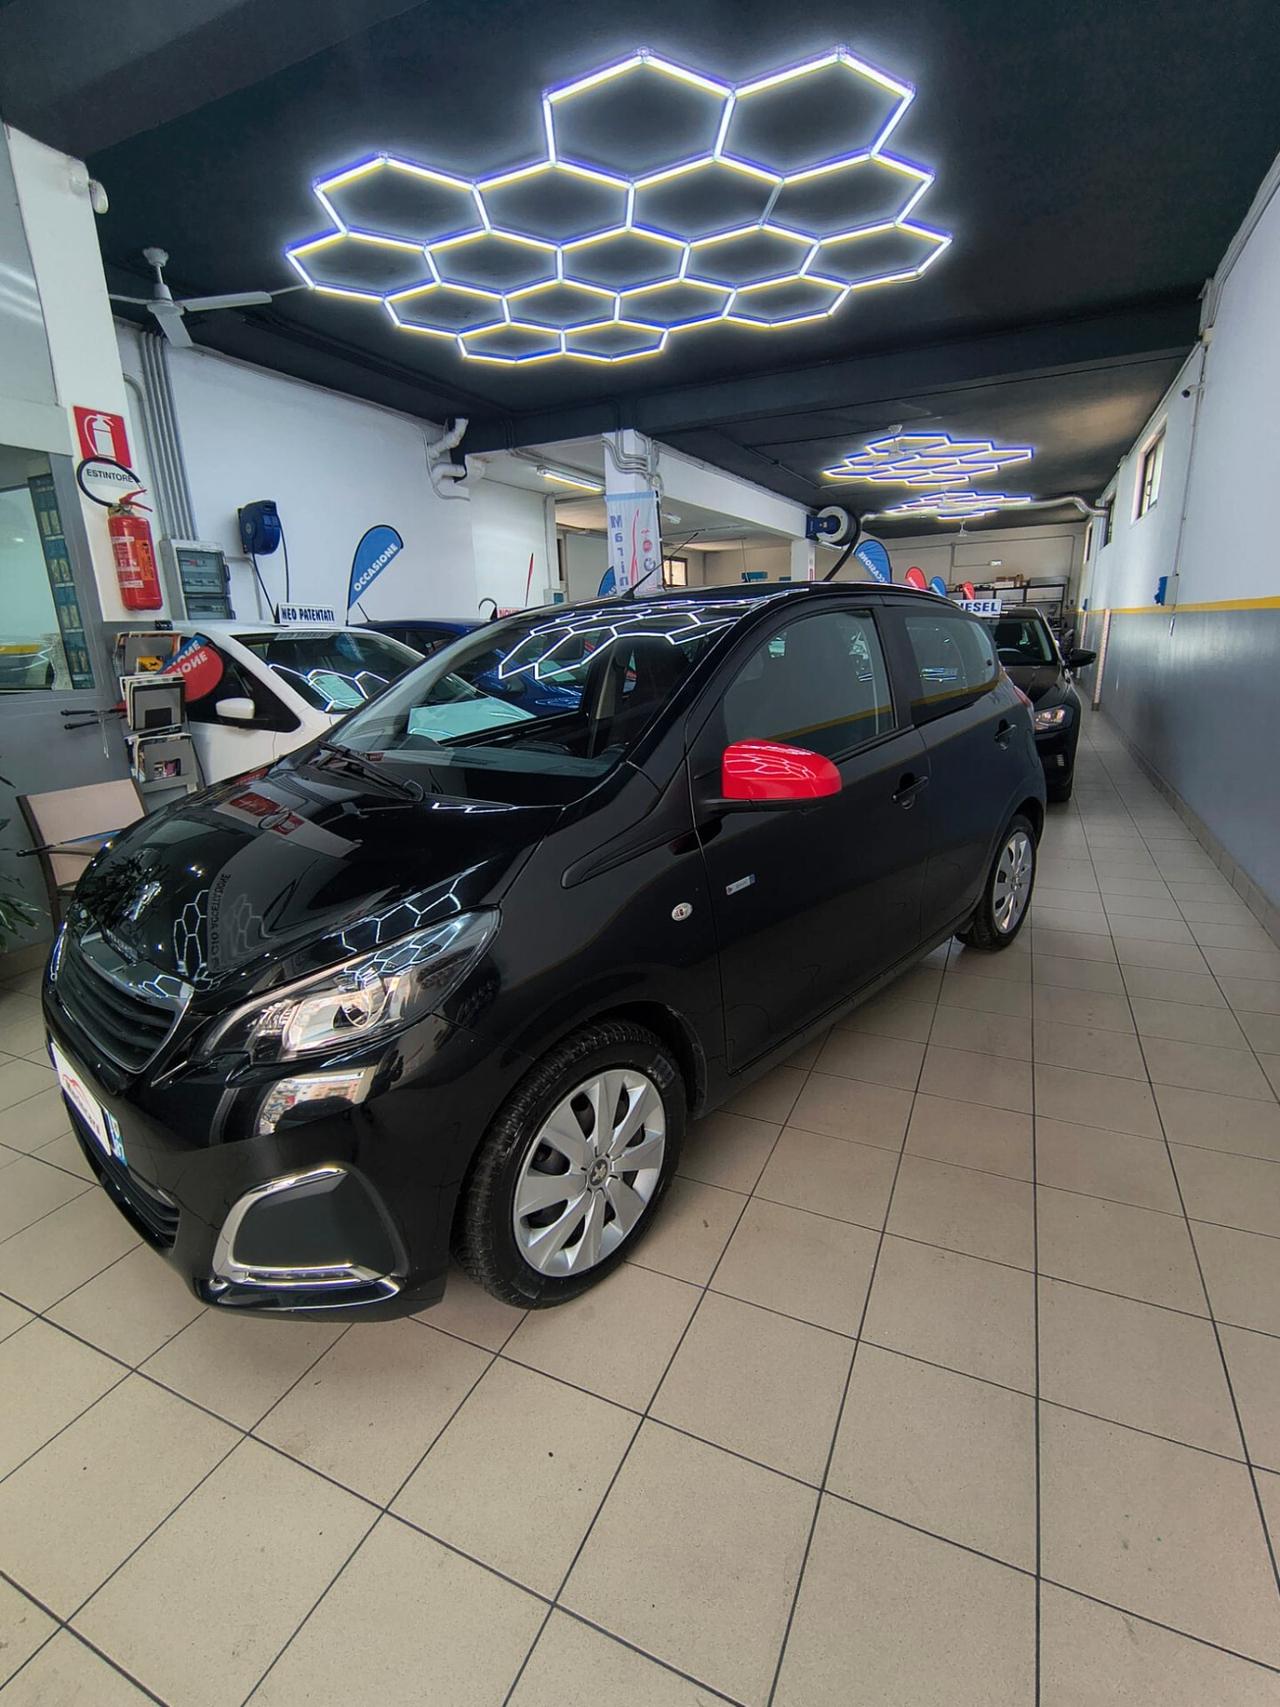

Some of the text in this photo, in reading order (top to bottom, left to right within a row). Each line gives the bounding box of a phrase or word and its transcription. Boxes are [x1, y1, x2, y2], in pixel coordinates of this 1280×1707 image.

[86, 468, 133, 483] ESTINTORE
[354, 543, 398, 592] OCCASIONE
[281, 607, 335, 621] NEO PATENTATI
[959, 602, 998, 612] IESEL
